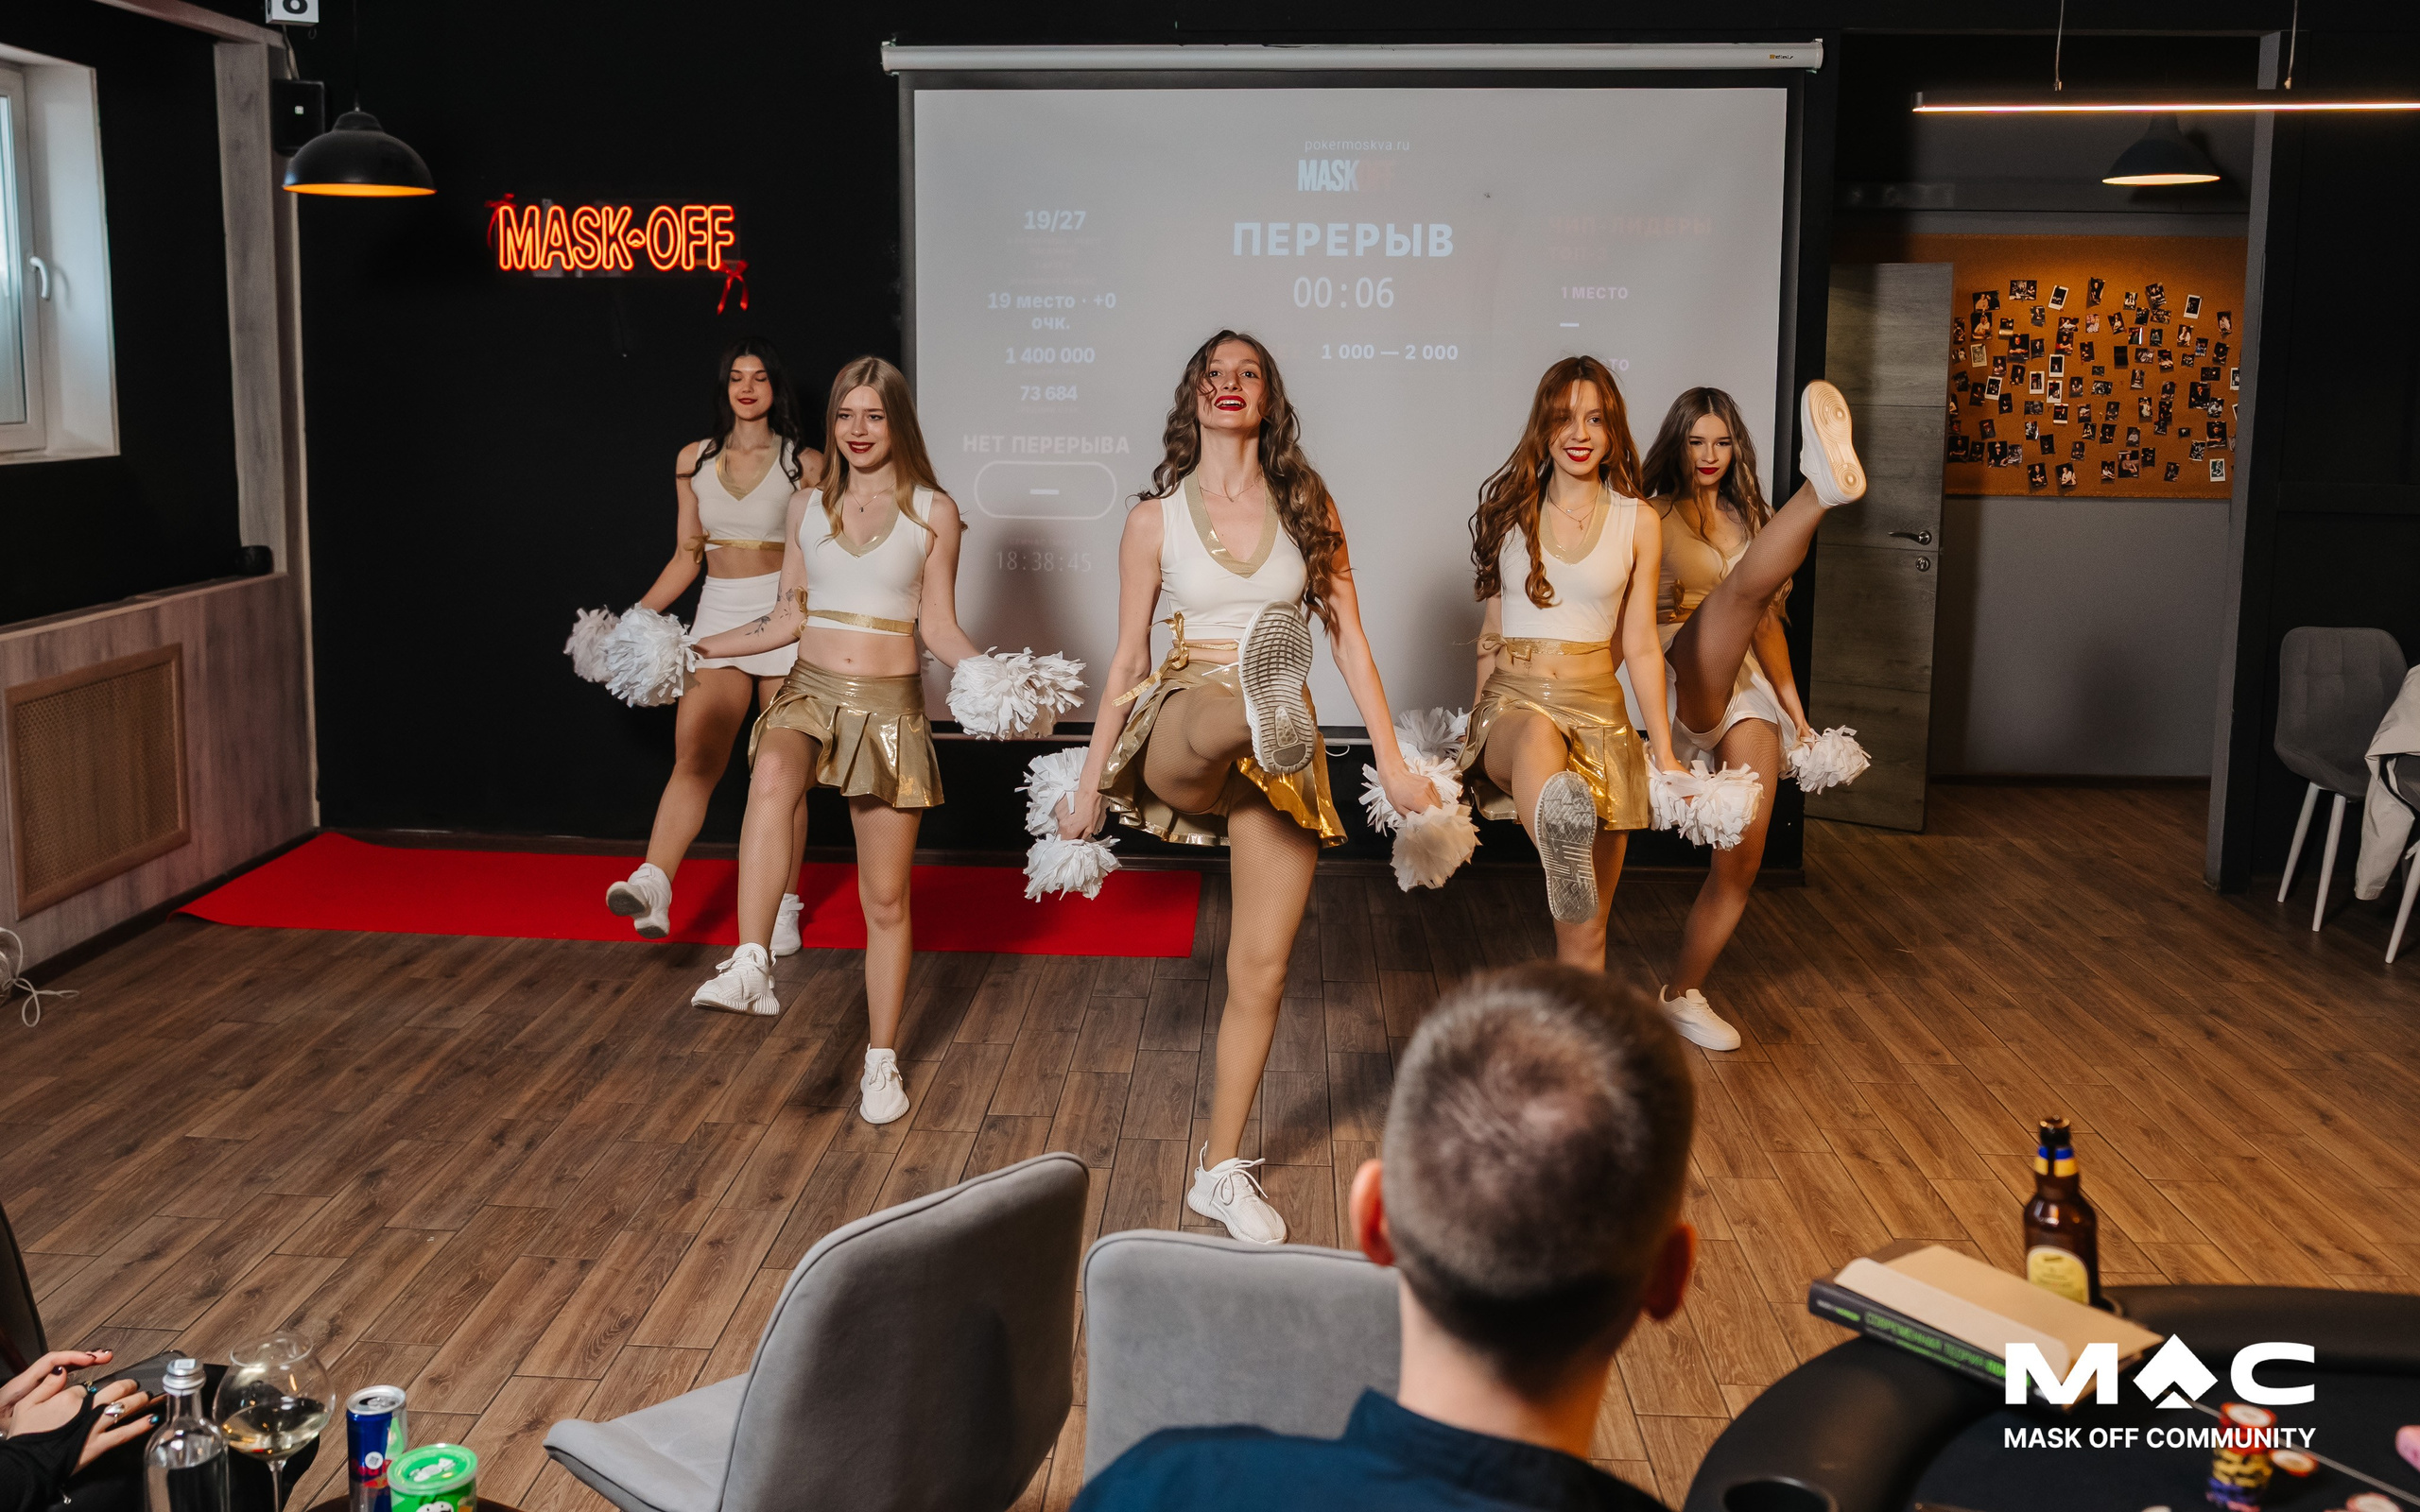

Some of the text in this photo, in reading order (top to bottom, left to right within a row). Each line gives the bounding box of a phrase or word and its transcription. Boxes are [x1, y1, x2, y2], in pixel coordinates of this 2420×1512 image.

[1305, 140, 1410, 153] pokermoskva.ru
[1024, 210, 1087, 232] 19/27
[1232, 221, 1455, 258] ПЕРЕРЫВ
[987, 292, 1011, 309] 19
[1016, 295, 1076, 309] место
[1093, 292, 1117, 309] +0
[1292, 275, 1395, 309] 00:06
[1571, 286, 1629, 300] МЕСТО
[1031, 318, 1070, 330] очк.
[962, 434, 1131, 455] НЕТ ПЕРЕРЫВА
[995, 550, 1093, 573] 18:38:45
